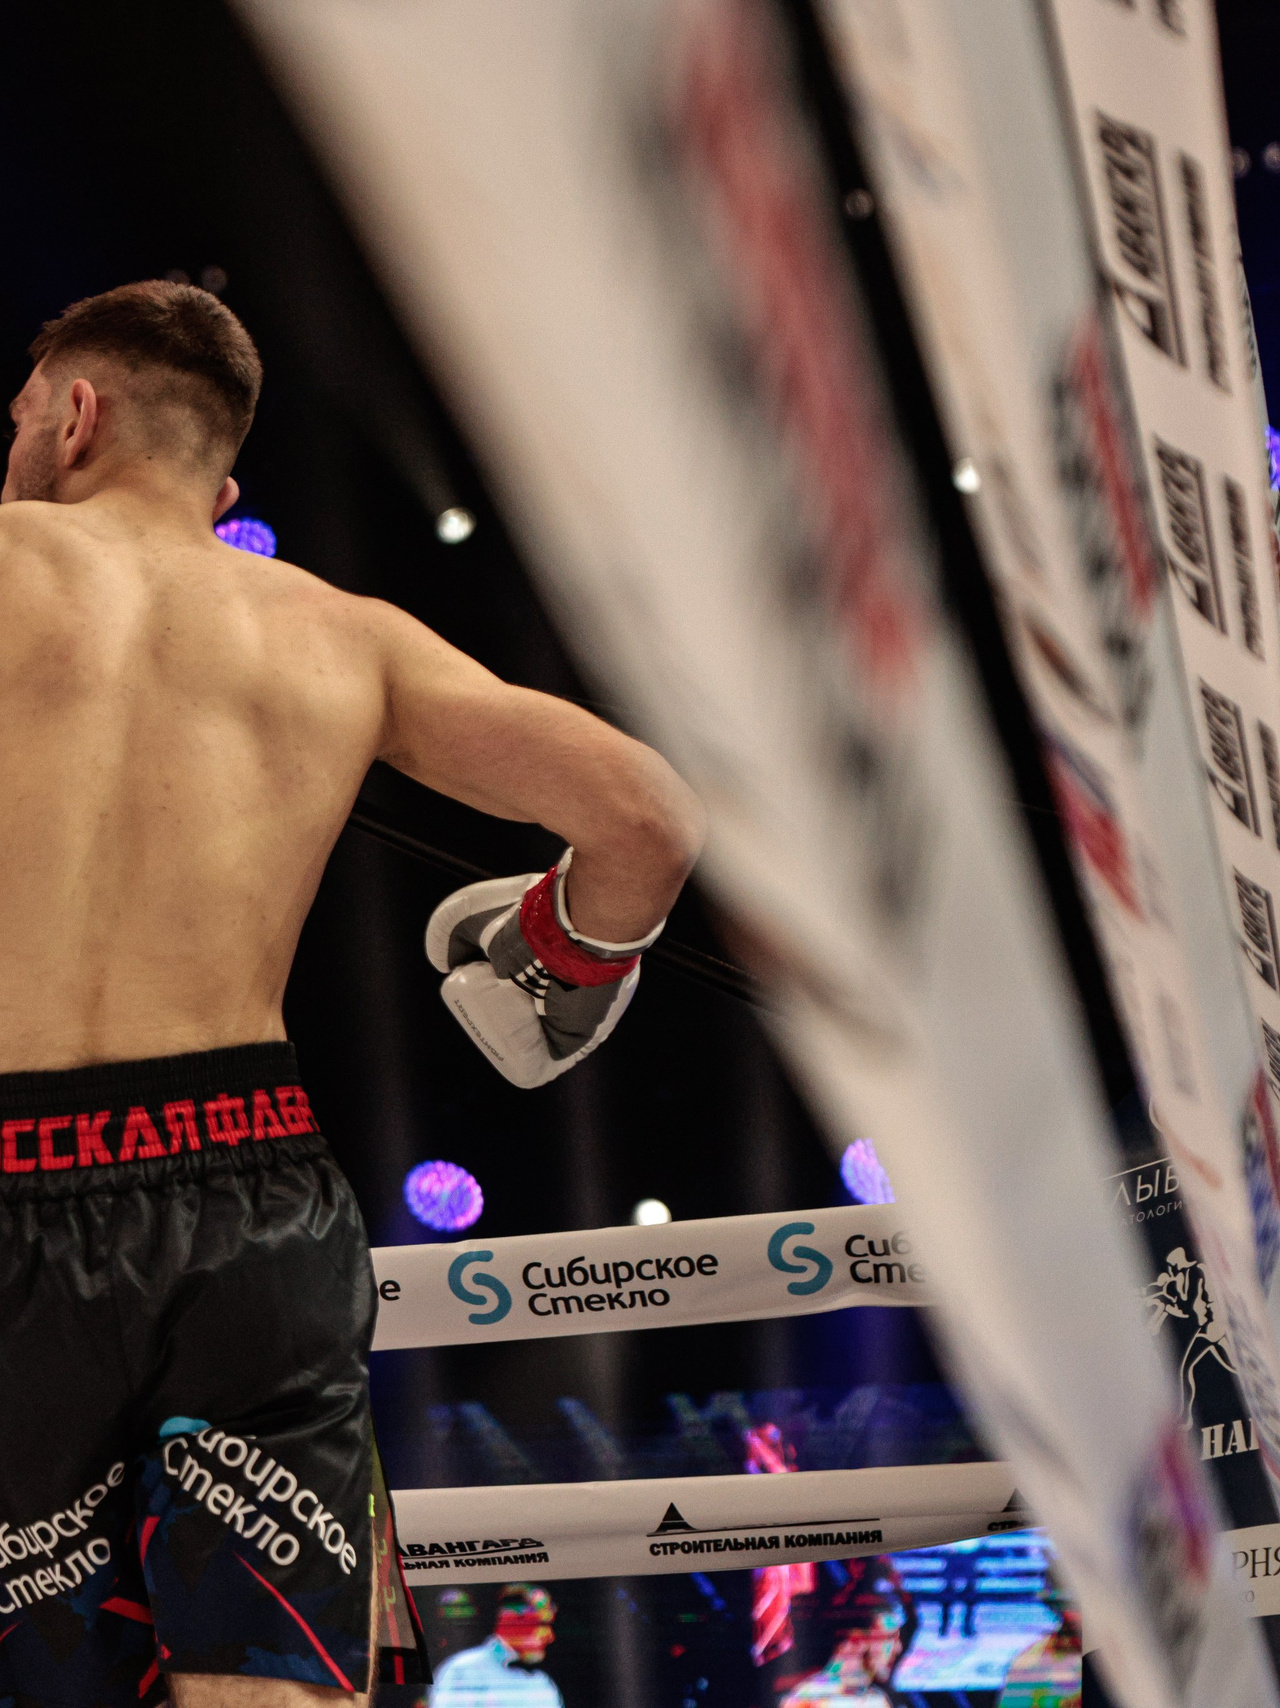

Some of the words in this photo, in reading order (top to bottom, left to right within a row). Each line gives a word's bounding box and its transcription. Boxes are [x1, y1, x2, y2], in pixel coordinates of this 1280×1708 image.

[522, 1253, 719, 1290] Сибирское
[528, 1288, 671, 1317] Стекло
[163, 1437, 301, 1567] Стекло
[649, 1534, 781, 1557] СТРОИТЕЛЬНАЯ
[784, 1529, 883, 1549] КОМПАНИЯ
[453, 1551, 550, 1568] КОМПАНИЯ
